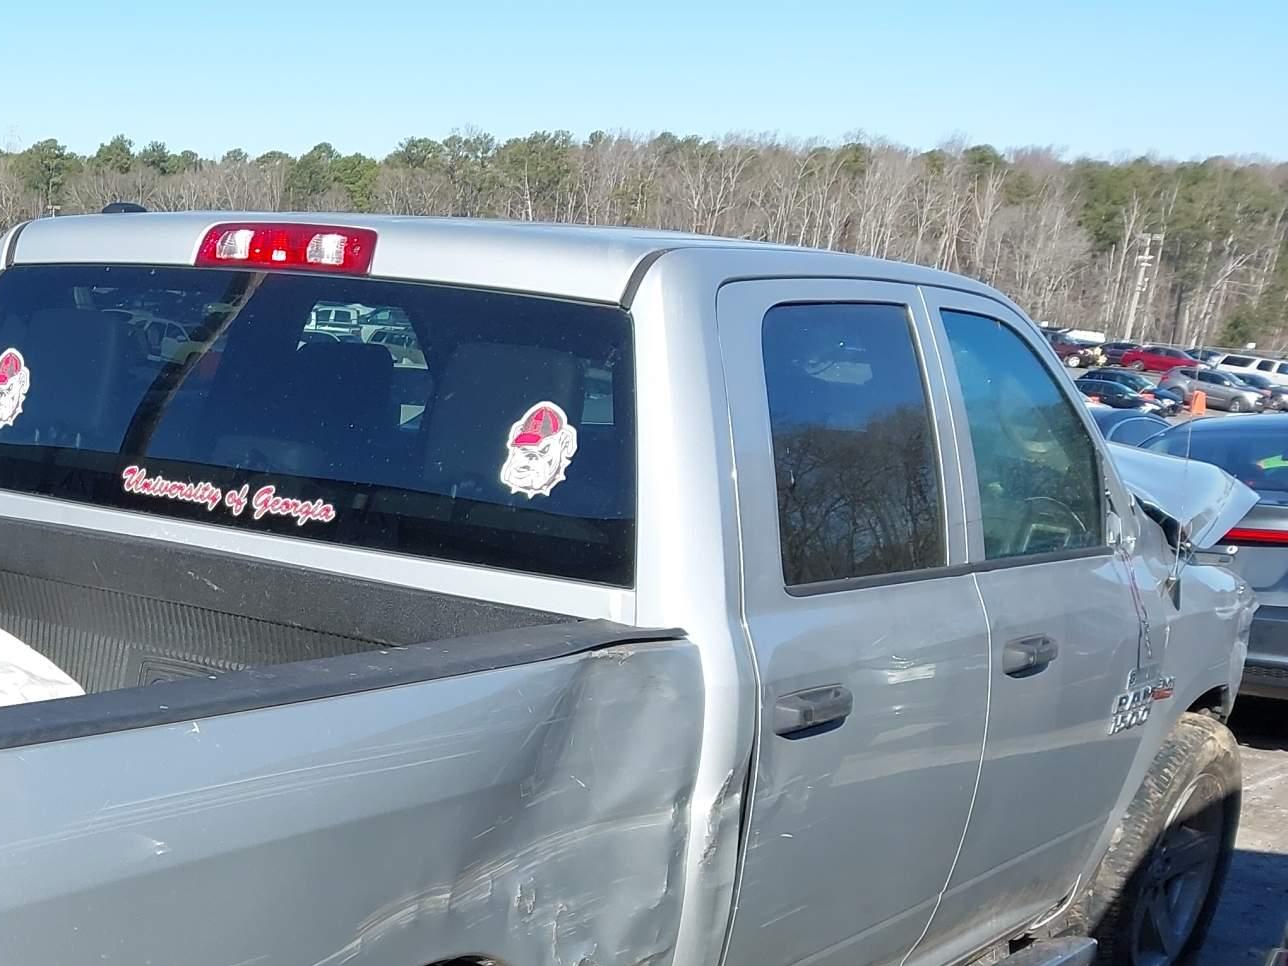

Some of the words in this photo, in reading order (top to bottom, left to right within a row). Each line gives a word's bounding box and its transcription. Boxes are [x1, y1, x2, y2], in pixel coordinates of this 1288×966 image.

[123, 465, 222, 511] University
[225, 484, 250, 516] of
[253, 485, 336, 526] Georgia
[1107, 709, 1151, 736] 1500
